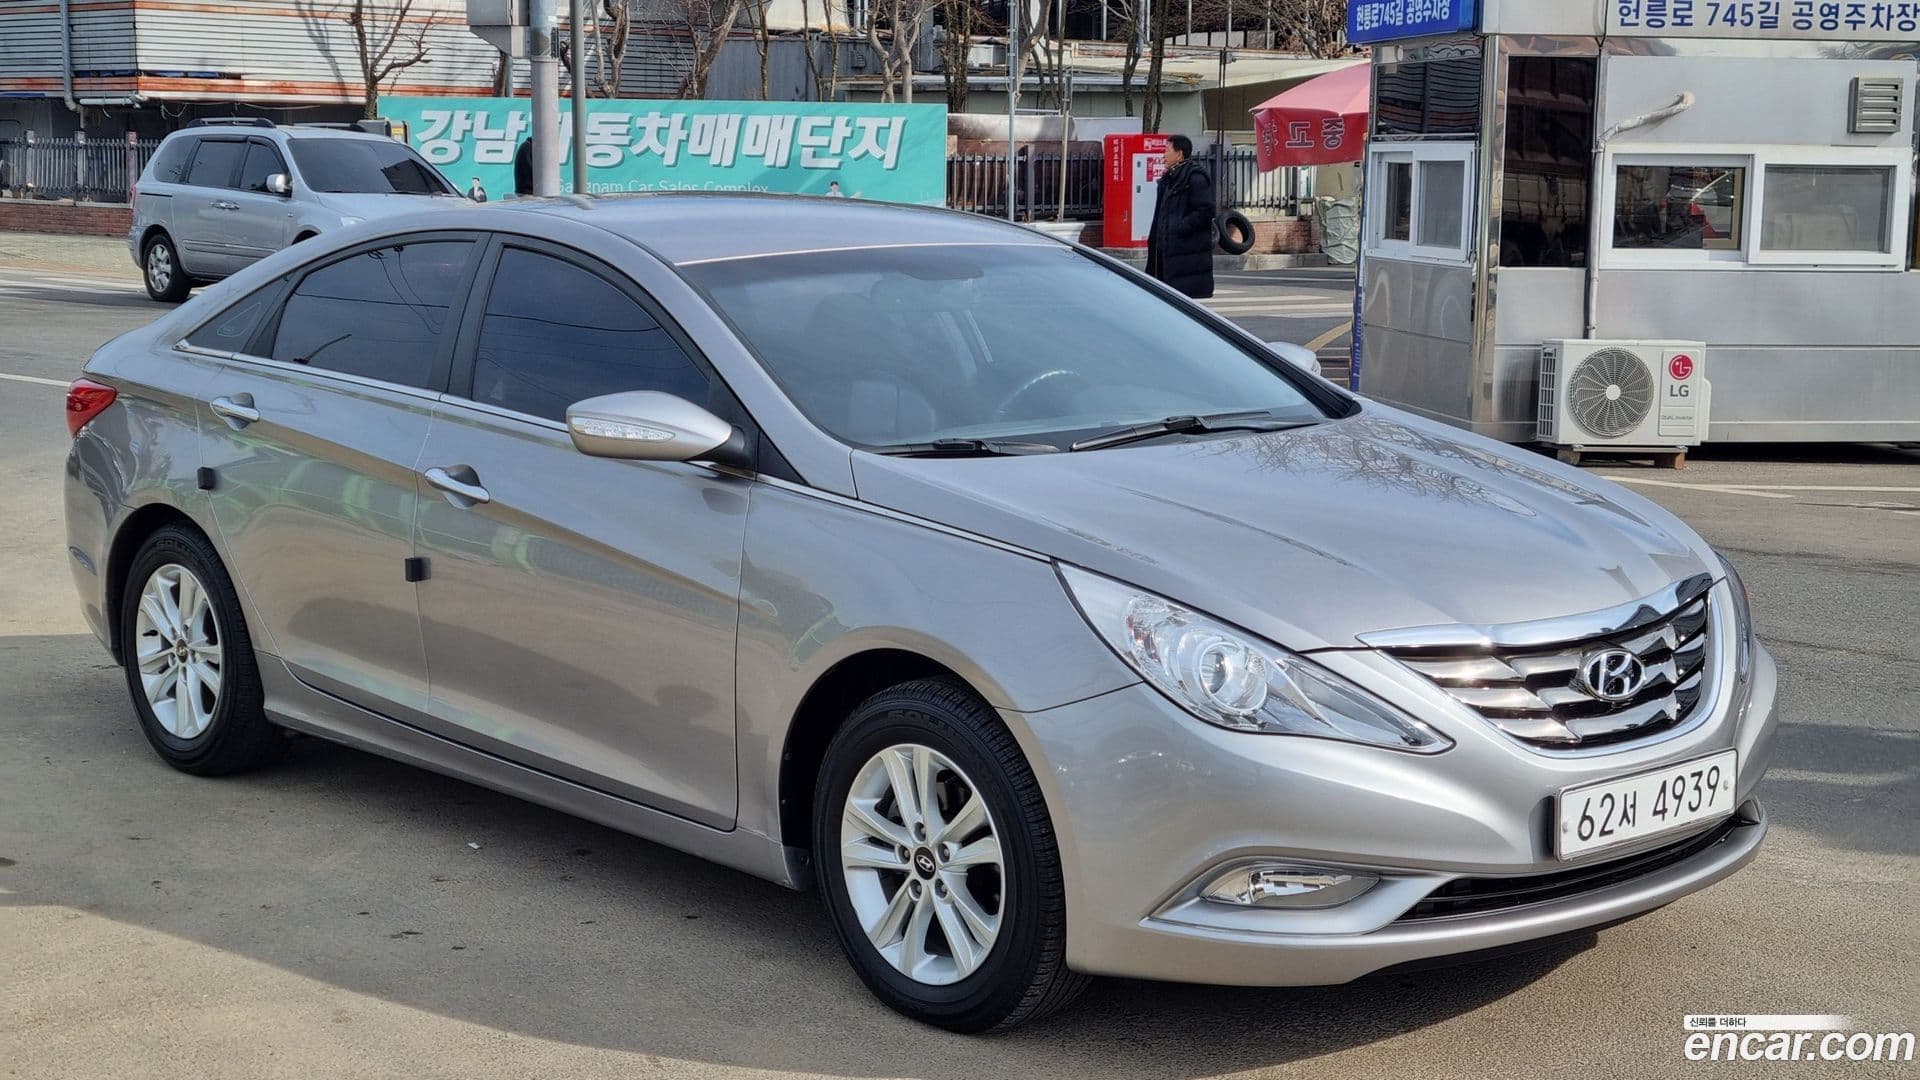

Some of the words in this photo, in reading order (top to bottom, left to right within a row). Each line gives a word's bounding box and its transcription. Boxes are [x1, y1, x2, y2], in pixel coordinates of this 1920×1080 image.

[1618, 0, 1694, 28] 헌릉로
[1706, 2, 1780, 29] 745길
[1791, 1, 1920, 32] 공영주차장
[559, 178, 623, 193] Gagnam
[628, 179, 654, 192] Car
[1670, 384, 1689, 397] LG
[1577, 790, 1637, 841] 62서
[1652, 765, 1720, 821] 4939
